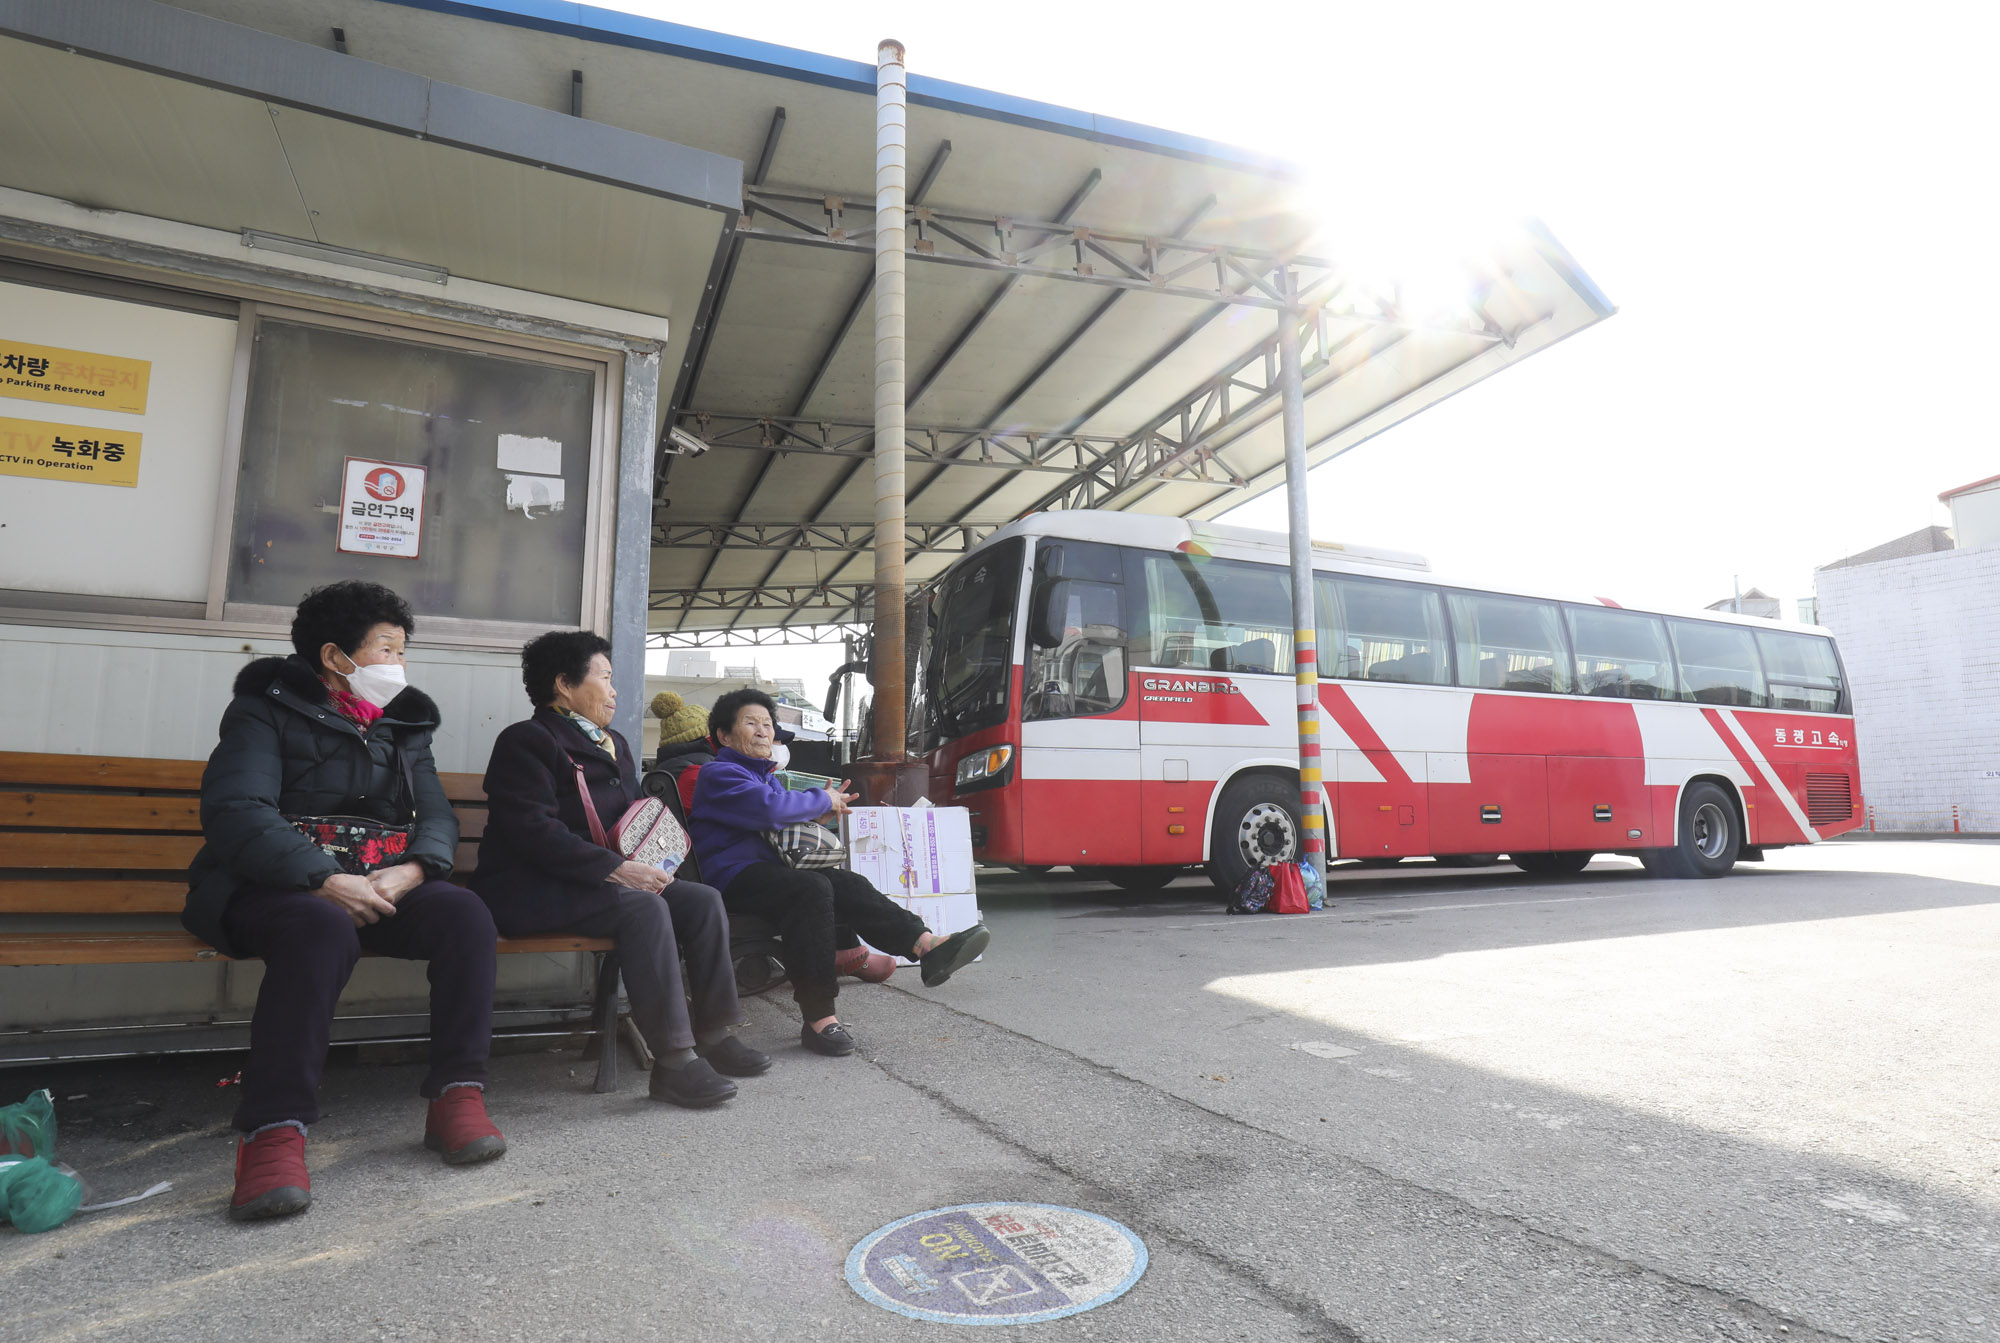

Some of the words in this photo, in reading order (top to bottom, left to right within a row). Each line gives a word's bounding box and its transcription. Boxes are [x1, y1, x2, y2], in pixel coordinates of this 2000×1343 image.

[0, 353, 50, 378] 차량
[53, 361, 139, 391] 주차금지
[6, 377, 51, 391] Parking
[54, 383, 105, 397] Reserved
[52, 436, 125, 462] 녹화중
[23, 456, 34, 465] in
[37, 458, 94, 471] Operation
[351, 501, 415, 521] 금연구역
[1143, 679, 1241, 694] GRANBIRD
[1775, 728, 1840, 746] 동광고속
[859, 817, 868, 829] 450
[920, 1233, 969, 1261] NO
